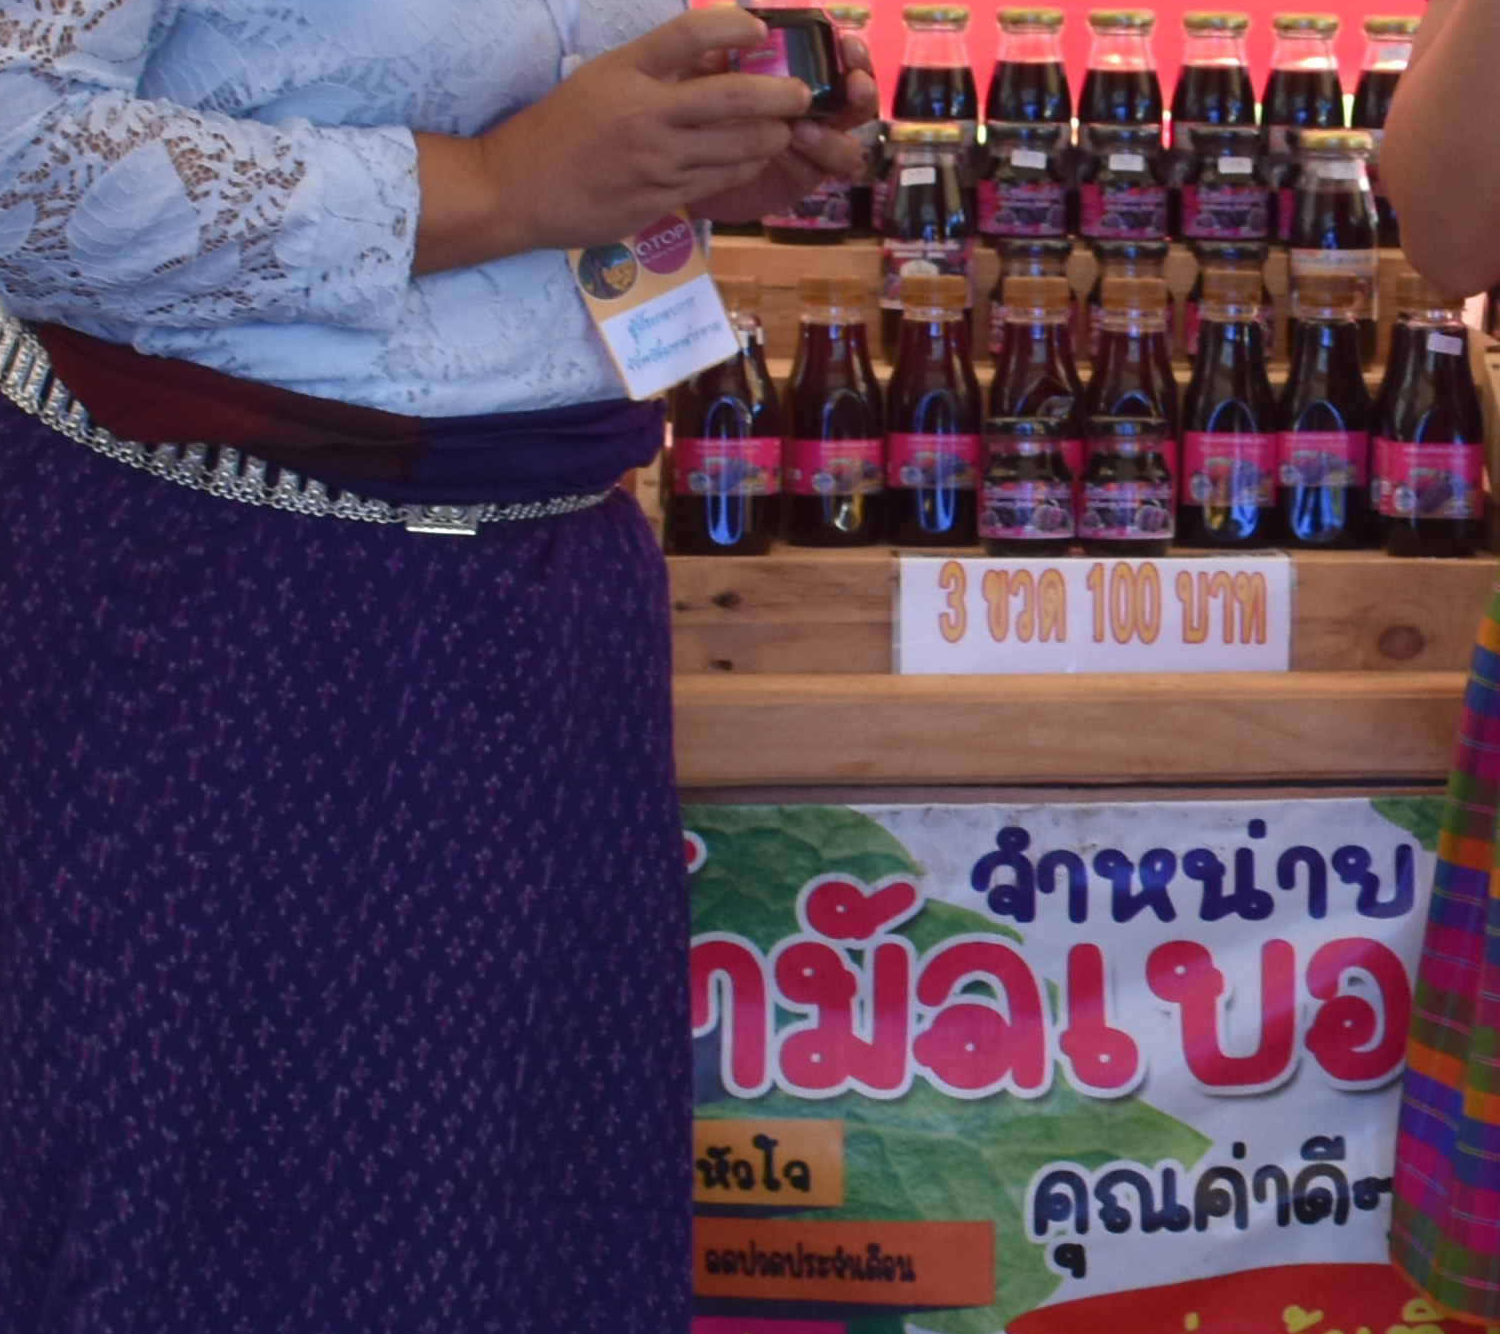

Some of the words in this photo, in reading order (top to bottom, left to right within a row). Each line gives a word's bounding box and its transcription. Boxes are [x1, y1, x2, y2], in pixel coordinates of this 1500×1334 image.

[635, 223, 687, 256] OTOP
[939, 560, 967, 643] 3
[981, 568, 1067, 644] ขวด
[1087, 561, 1162, 644] 100
[1175, 570, 1267, 645] บาท
[970, 818, 1414, 922] จำหน่าย
[1033, 1135, 1393, 1278] คุณค่าดี
[706, 1239, 916, 1283] ลดปวดประจำเดือน
